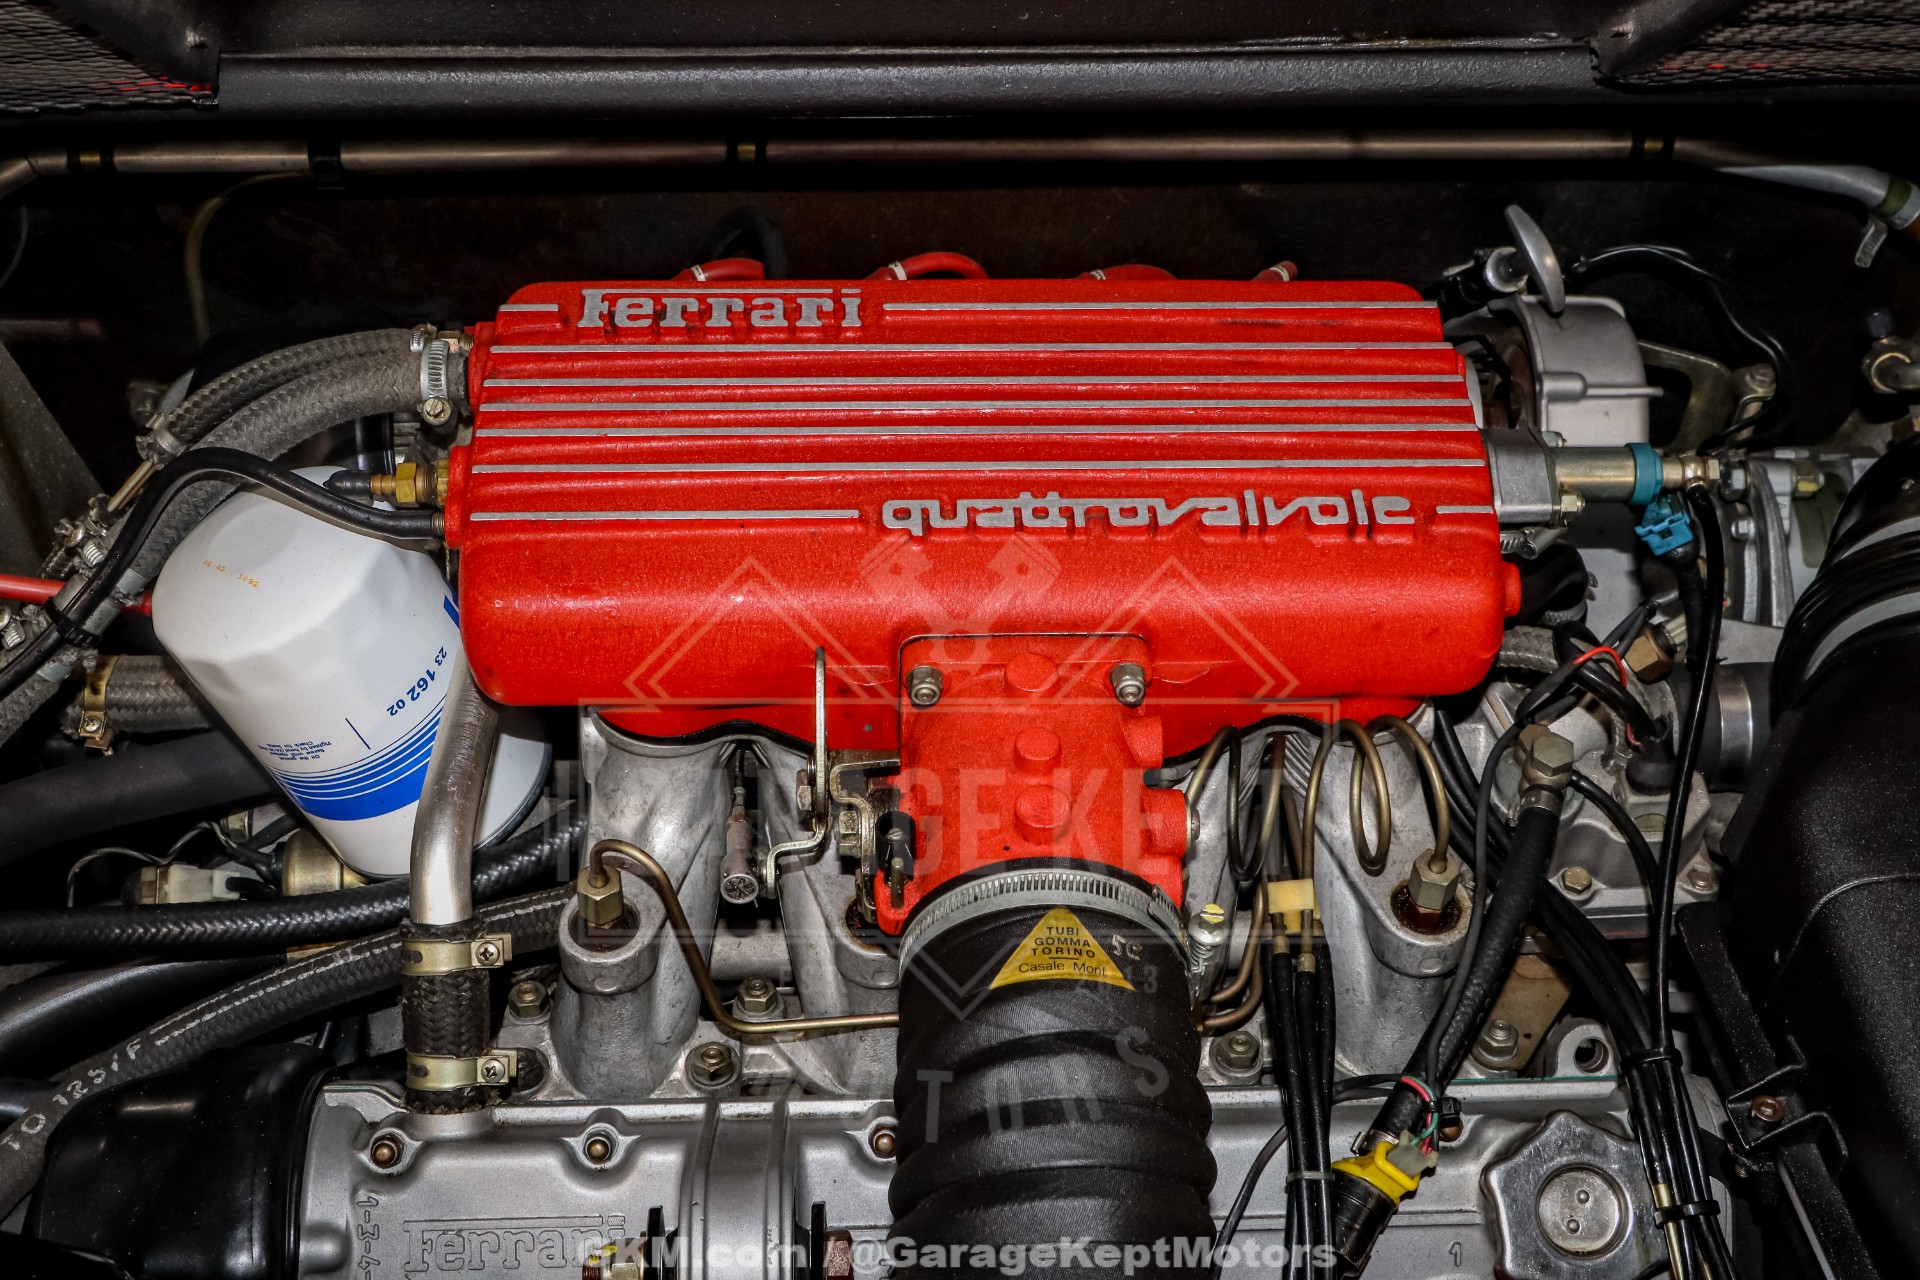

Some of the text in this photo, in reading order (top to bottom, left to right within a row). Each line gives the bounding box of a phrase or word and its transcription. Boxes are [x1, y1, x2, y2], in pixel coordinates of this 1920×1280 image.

[577, 288, 861, 328] Ferrari
[881, 488, 1416, 537] quattrovalvole
[386, 645, 448, 717] 23 162 02
[1046, 926, 1079, 936] TUBI
[1034, 937, 1091, 948] GOMMA
[1030, 946, 1096, 959] TORINO
[1018, 961, 1065, 974] Casale
[1449, 1241, 1462, 1267] 1
